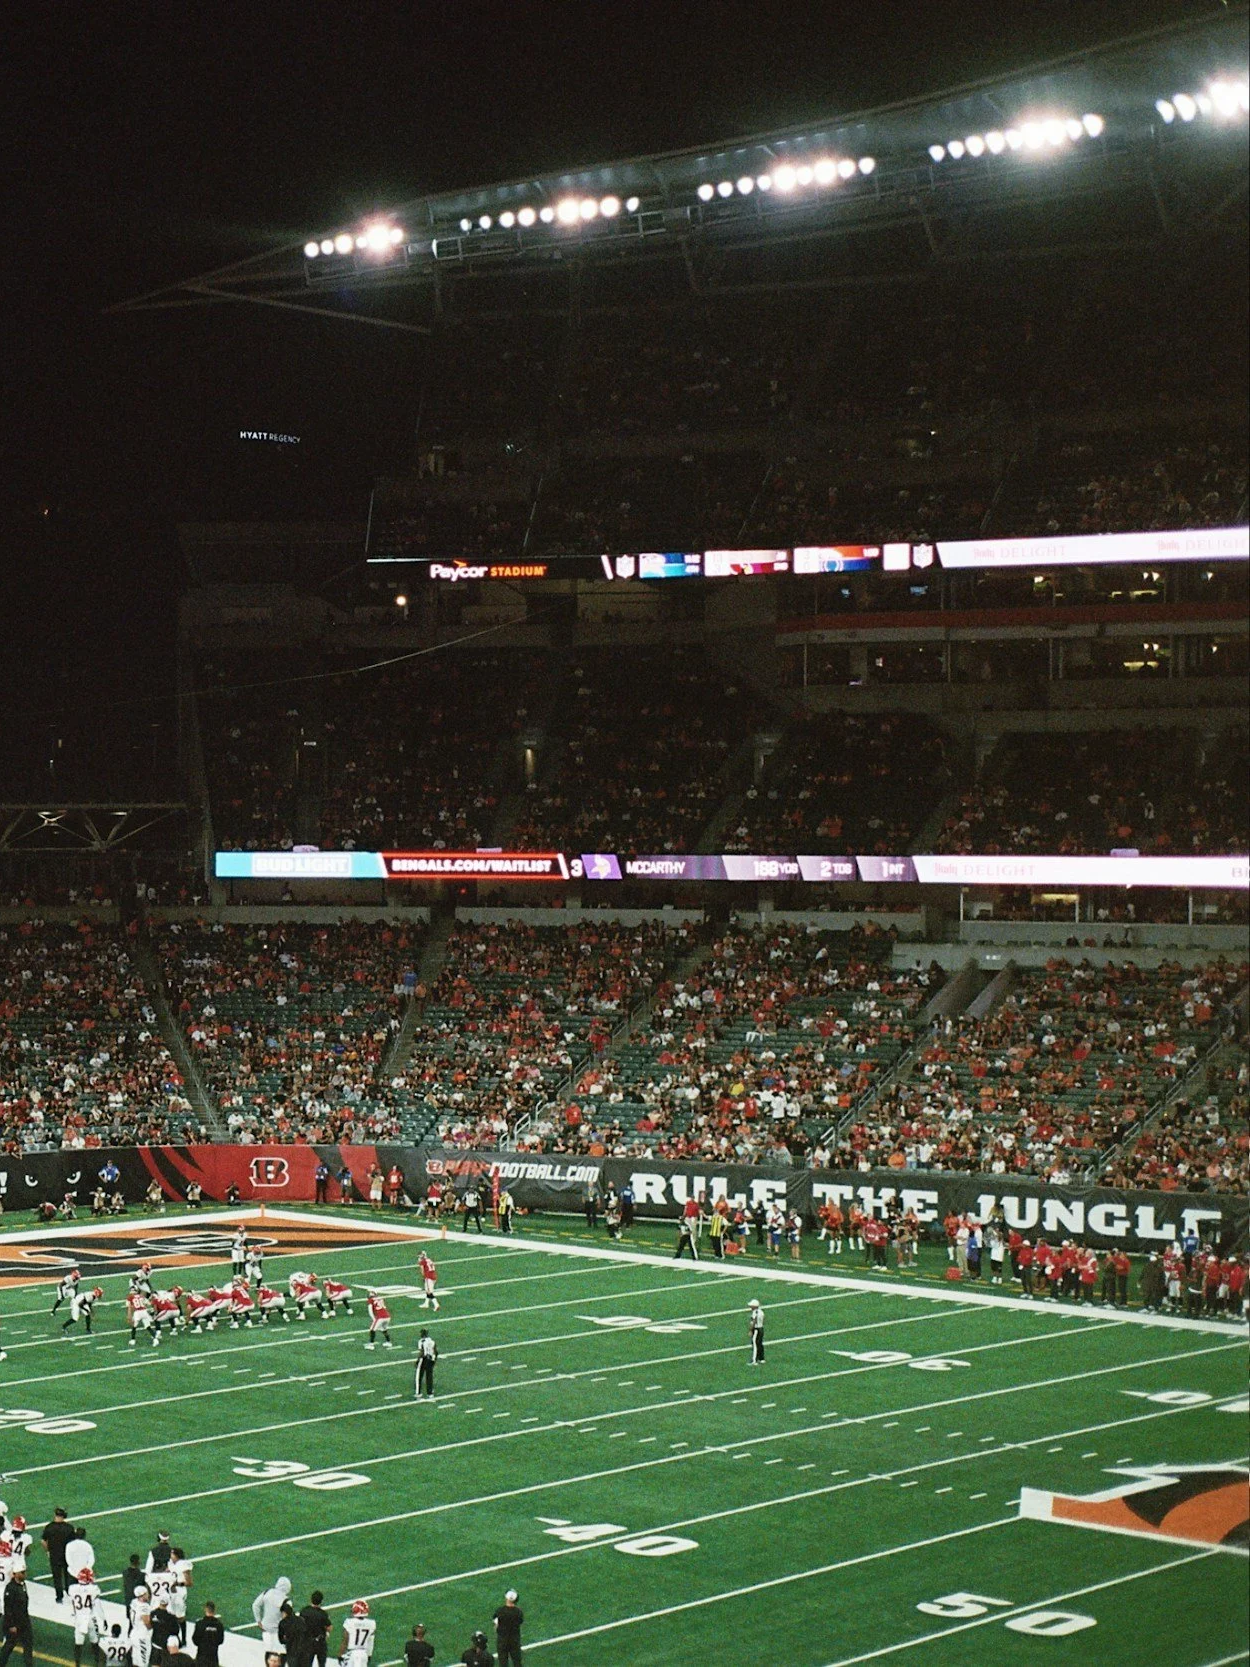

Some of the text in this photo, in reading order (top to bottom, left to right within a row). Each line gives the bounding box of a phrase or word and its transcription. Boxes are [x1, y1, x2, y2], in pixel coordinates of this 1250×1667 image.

[240, 431, 300, 443] HYATT REGENCY
[1186, 537, 1246, 551] DELIGH
[430, 563, 544, 582] Paycor STADIUM
[255, 858, 348, 872] BUD LIGHT
[391, 858, 552, 873] BENGALS.COM/WAITLIST
[570, 859, 583, 876] 3
[625, 860, 687, 875] MCCARTHY
[820, 861, 831, 877] 2
[629, 1172, 787, 1212] RULE
[812, 1183, 939, 1222] THE
[543, 1523, 699, 1556] 40
[152, 1582, 170, 1597] 23
[74, 1595, 93, 1610] 34
[916, 1592, 1098, 1637] 50
[355, 1629, 369, 1646] 17
[107, 1646, 127, 1661] 28
